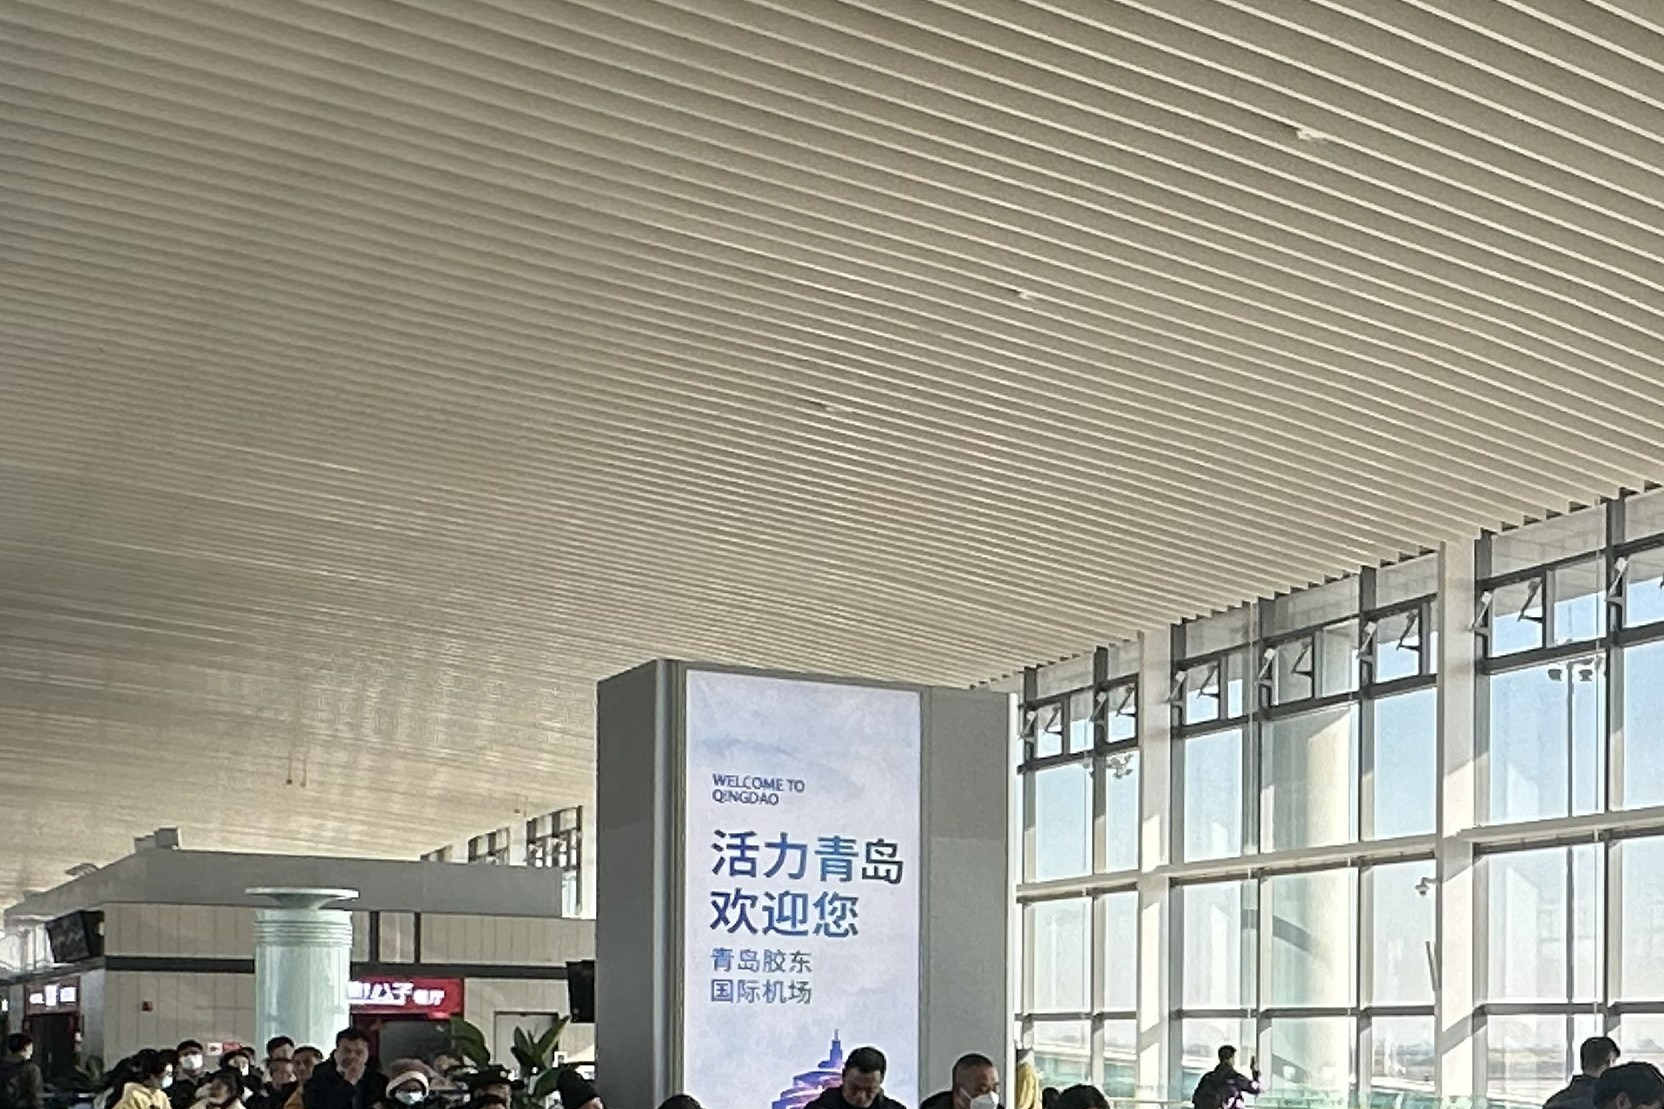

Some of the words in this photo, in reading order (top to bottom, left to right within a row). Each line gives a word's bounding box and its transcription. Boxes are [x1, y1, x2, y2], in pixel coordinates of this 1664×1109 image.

[712, 773, 783, 792] WELCOME
[787, 778, 805, 793] TO
[712, 788, 780, 806] QINGDAO
[711, 829, 904, 885] 活力青岛
[710, 887, 859, 938] 欢迎您
[710, 947, 813, 974] 青岛胶东
[710, 979, 813, 1005] 国际机场
